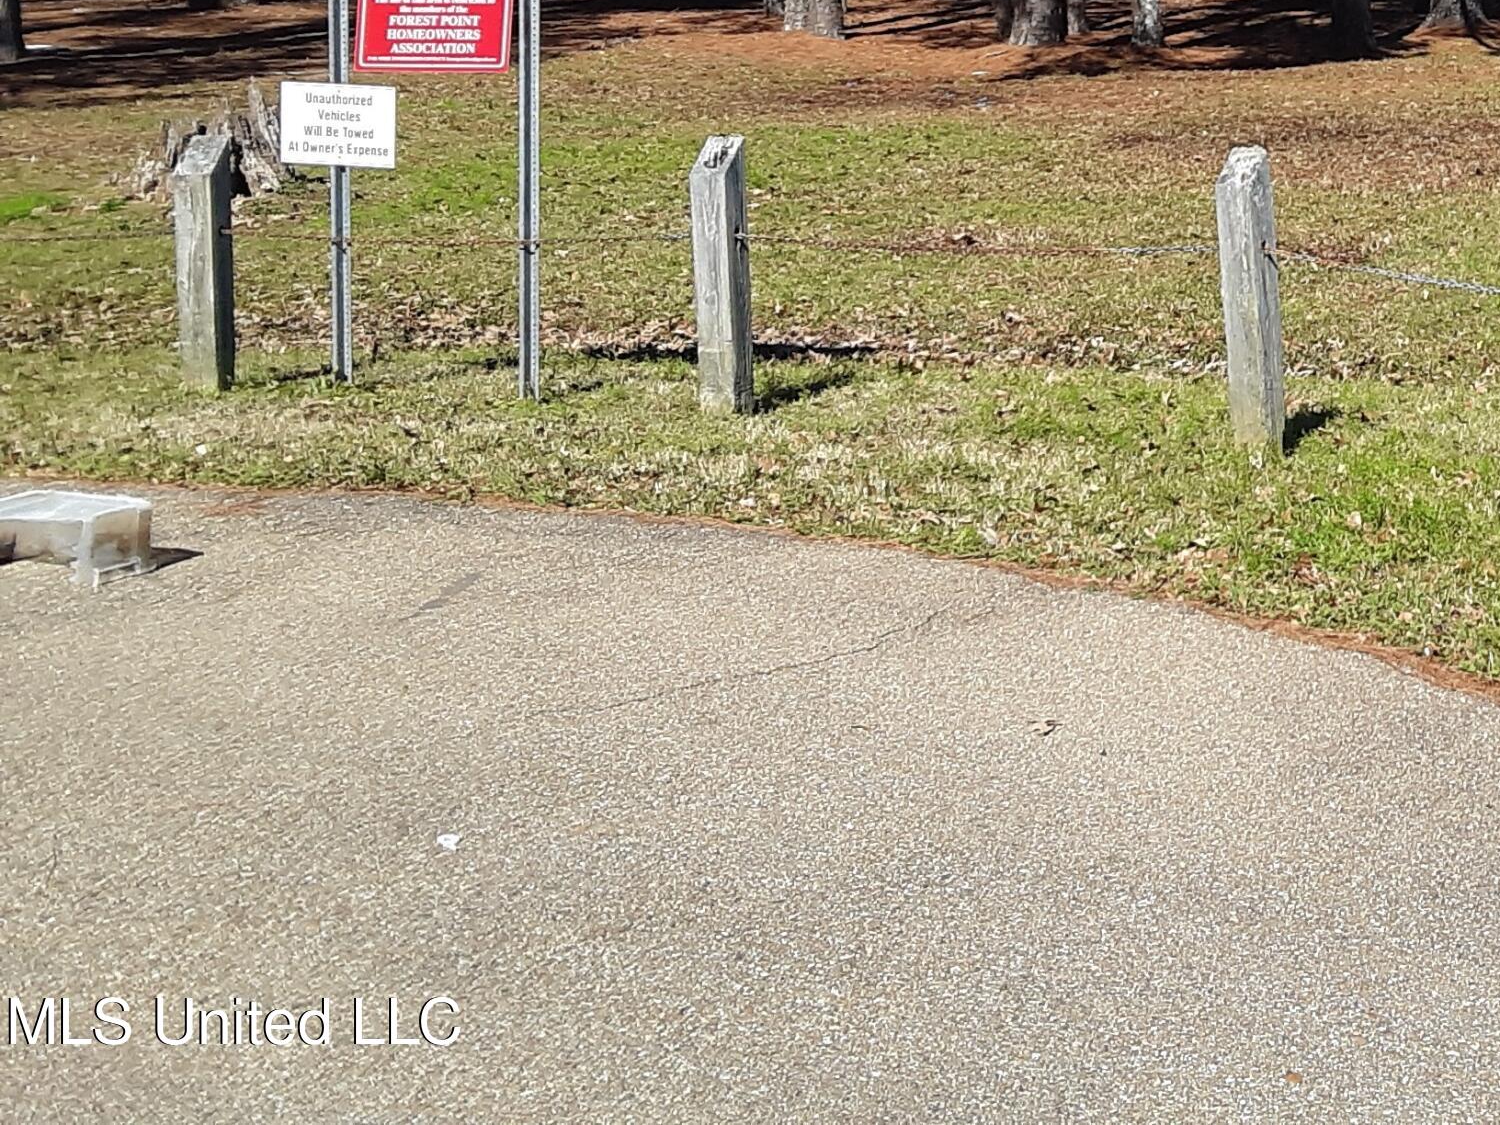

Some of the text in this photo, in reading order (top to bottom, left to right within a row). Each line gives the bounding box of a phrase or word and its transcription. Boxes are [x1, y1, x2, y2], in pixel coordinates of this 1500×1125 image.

[389, 15, 480, 26] FOREST POINT
[386, 28, 480, 40] HOMEOWNERS
[390, 42, 476, 54] ASSOCIATION
[306, 92, 373, 106] Unauthorized
[318, 110, 361, 122] Vehicles
[304, 126, 374, 140] Will Be Towed
[288, 141, 388, 156] At Owner's Expense
